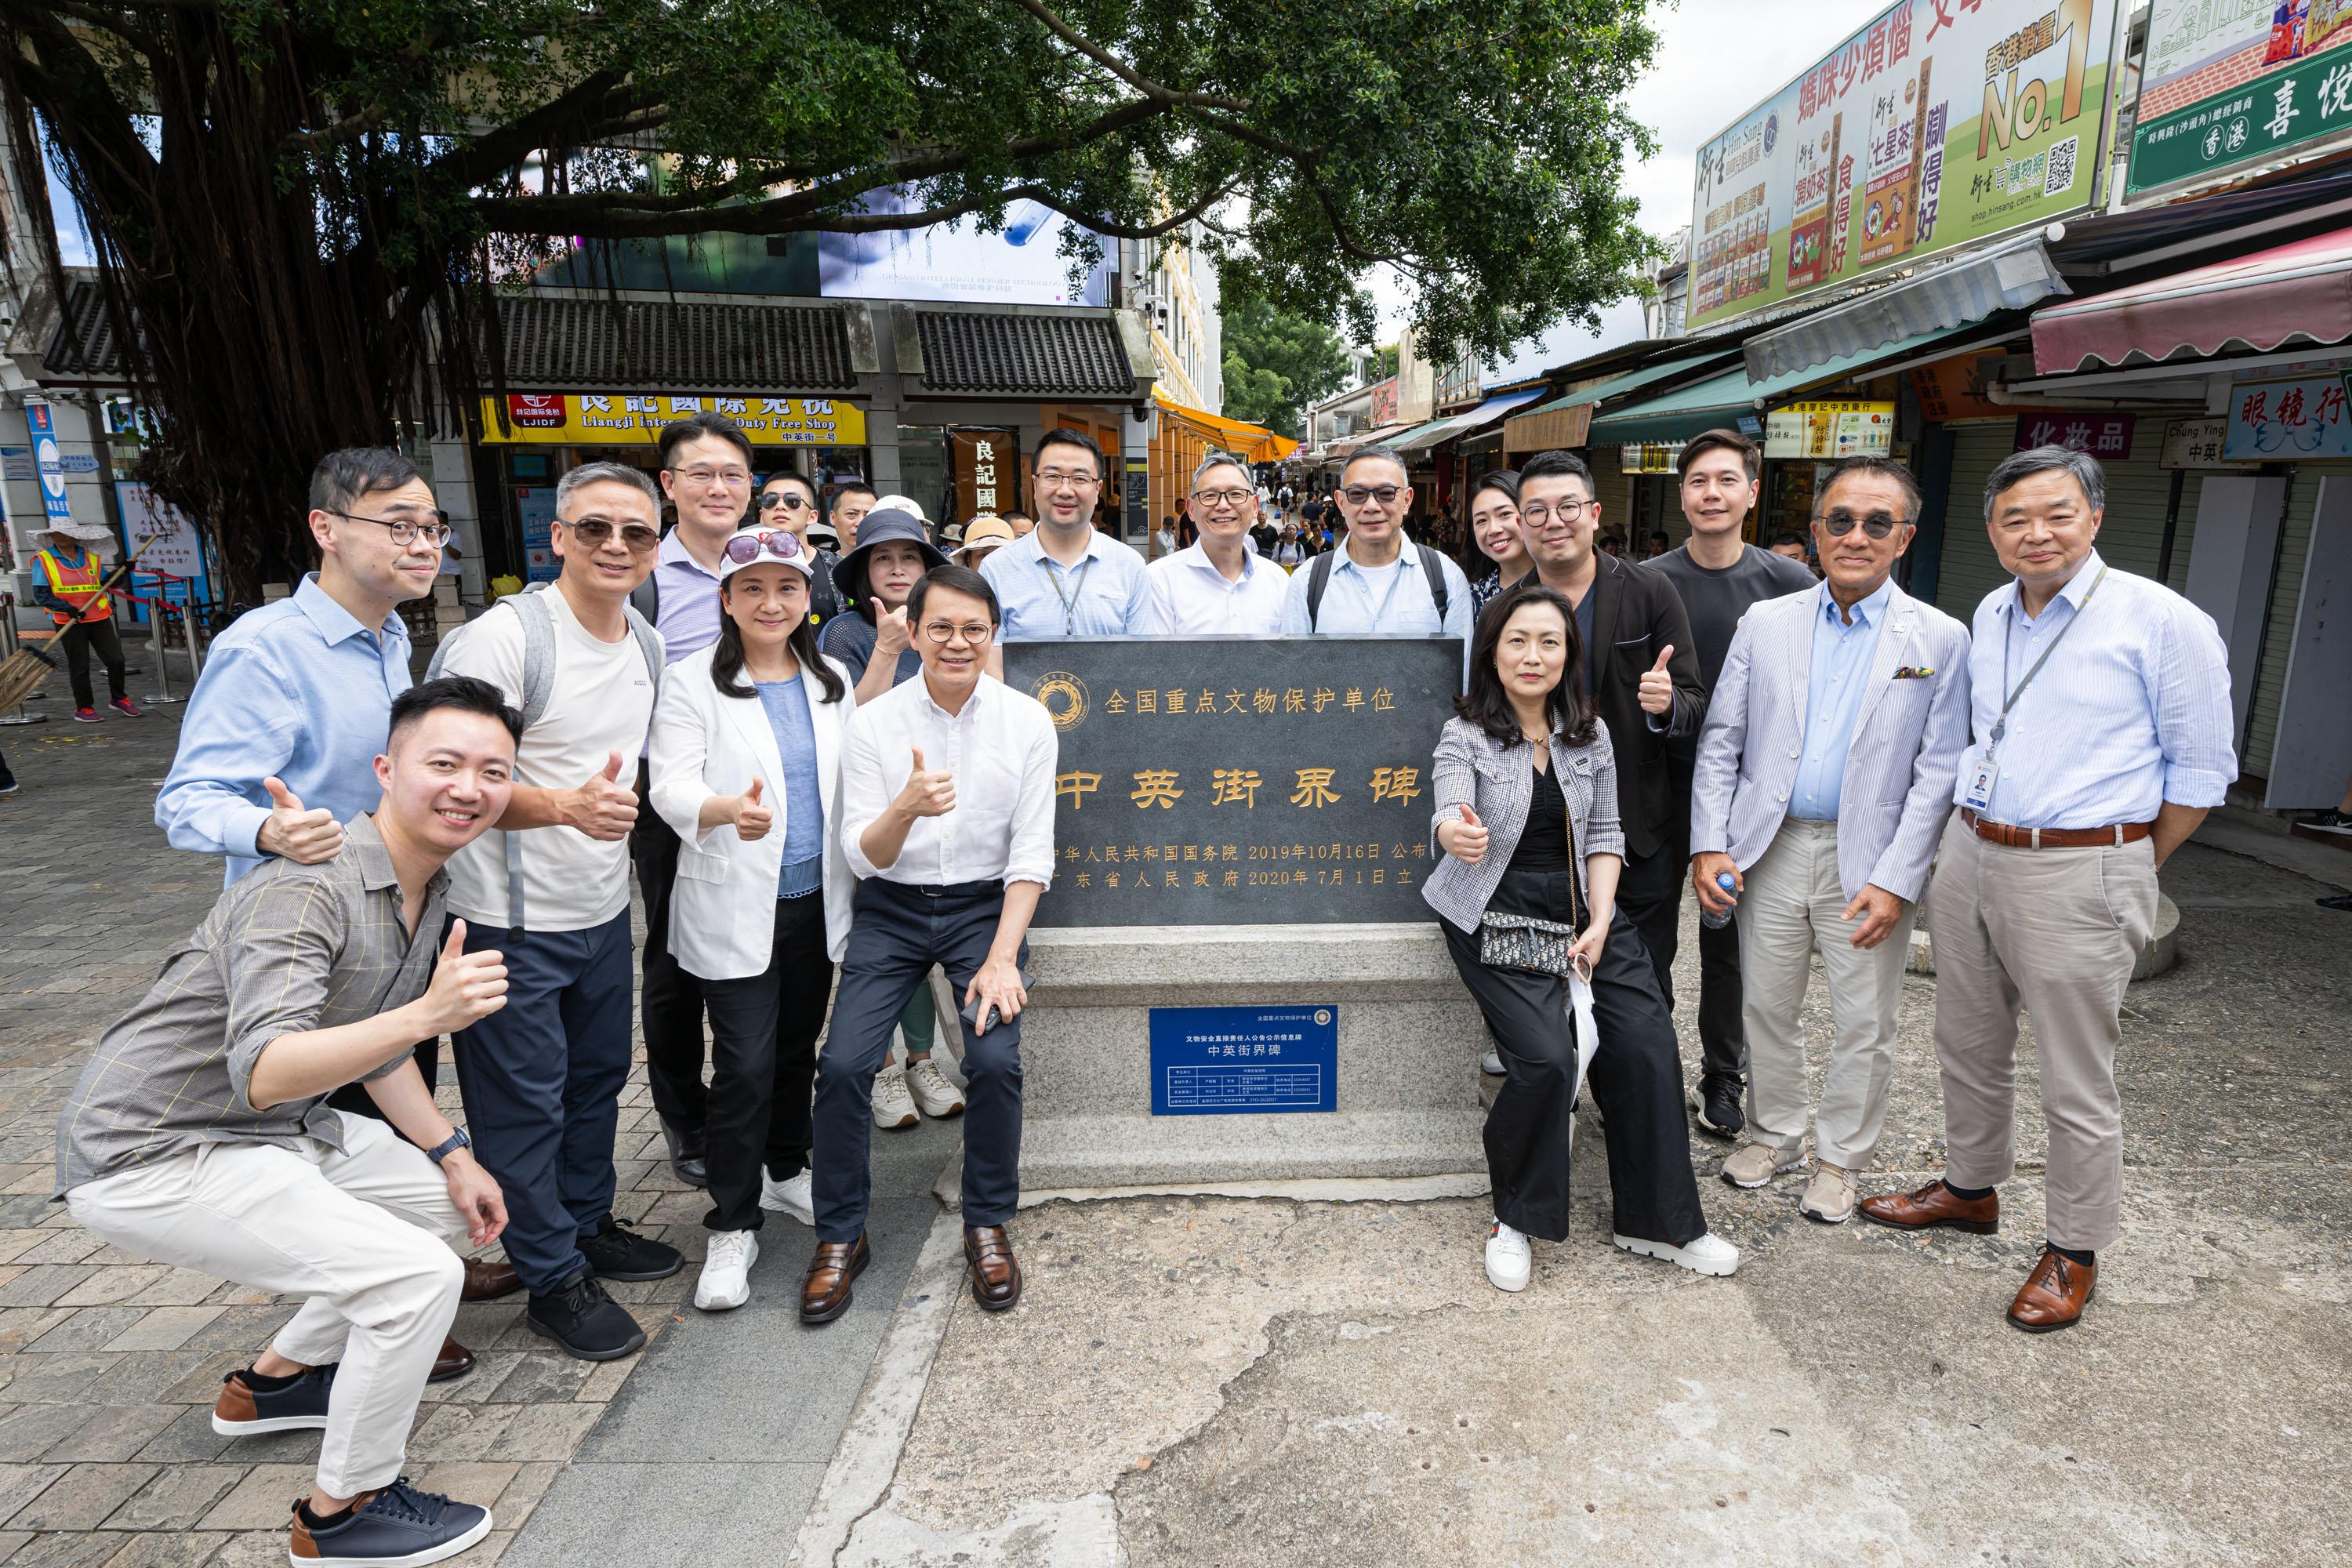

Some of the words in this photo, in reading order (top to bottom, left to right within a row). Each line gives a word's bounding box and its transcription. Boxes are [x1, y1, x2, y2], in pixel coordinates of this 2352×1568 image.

[1798, 0, 1914, 125] 媽咪少煩惱
[1985, 9, 2056, 82] 香港銷量
[1727, 133, 1741, 156] Hin
[1743, 122, 1762, 145] Sang
[1872, 120, 1911, 166] 七星茶
[1916, 100, 1948, 245] 瞓得好
[2009, 151, 2045, 185] 購物網
[1830, 154, 1855, 274] 食得好
[1971, 190, 2042, 222] shop.hinsang.com.hk
[582, 416, 633, 429] Liangji
[736, 417, 768, 430] Duty
[772, 418, 801, 429] Free
[806, 418, 835, 430] Shop
[2241, 386, 2346, 428] 眼镜行
[782, 433, 837, 442] 中英街一号
[2169, 426, 2198, 438] Chung
[2205, 424, 2223, 437] Ying
[2188, 443, 2226, 462] 中英
[975, 440, 997, 517] 良記國
[1104, 687, 1396, 715] 全国重点文物保护单位
[1055, 765, 1422, 809] 中英街界碑
[1249, 843, 1380, 861] 2019年10月16日
[1392, 842, 1428, 859] 公布
[1186, 1033, 1302, 1043] 文物安全直接责任人公告公示信息牌
[1207, 1044, 1281, 1058] 中英街界碑
